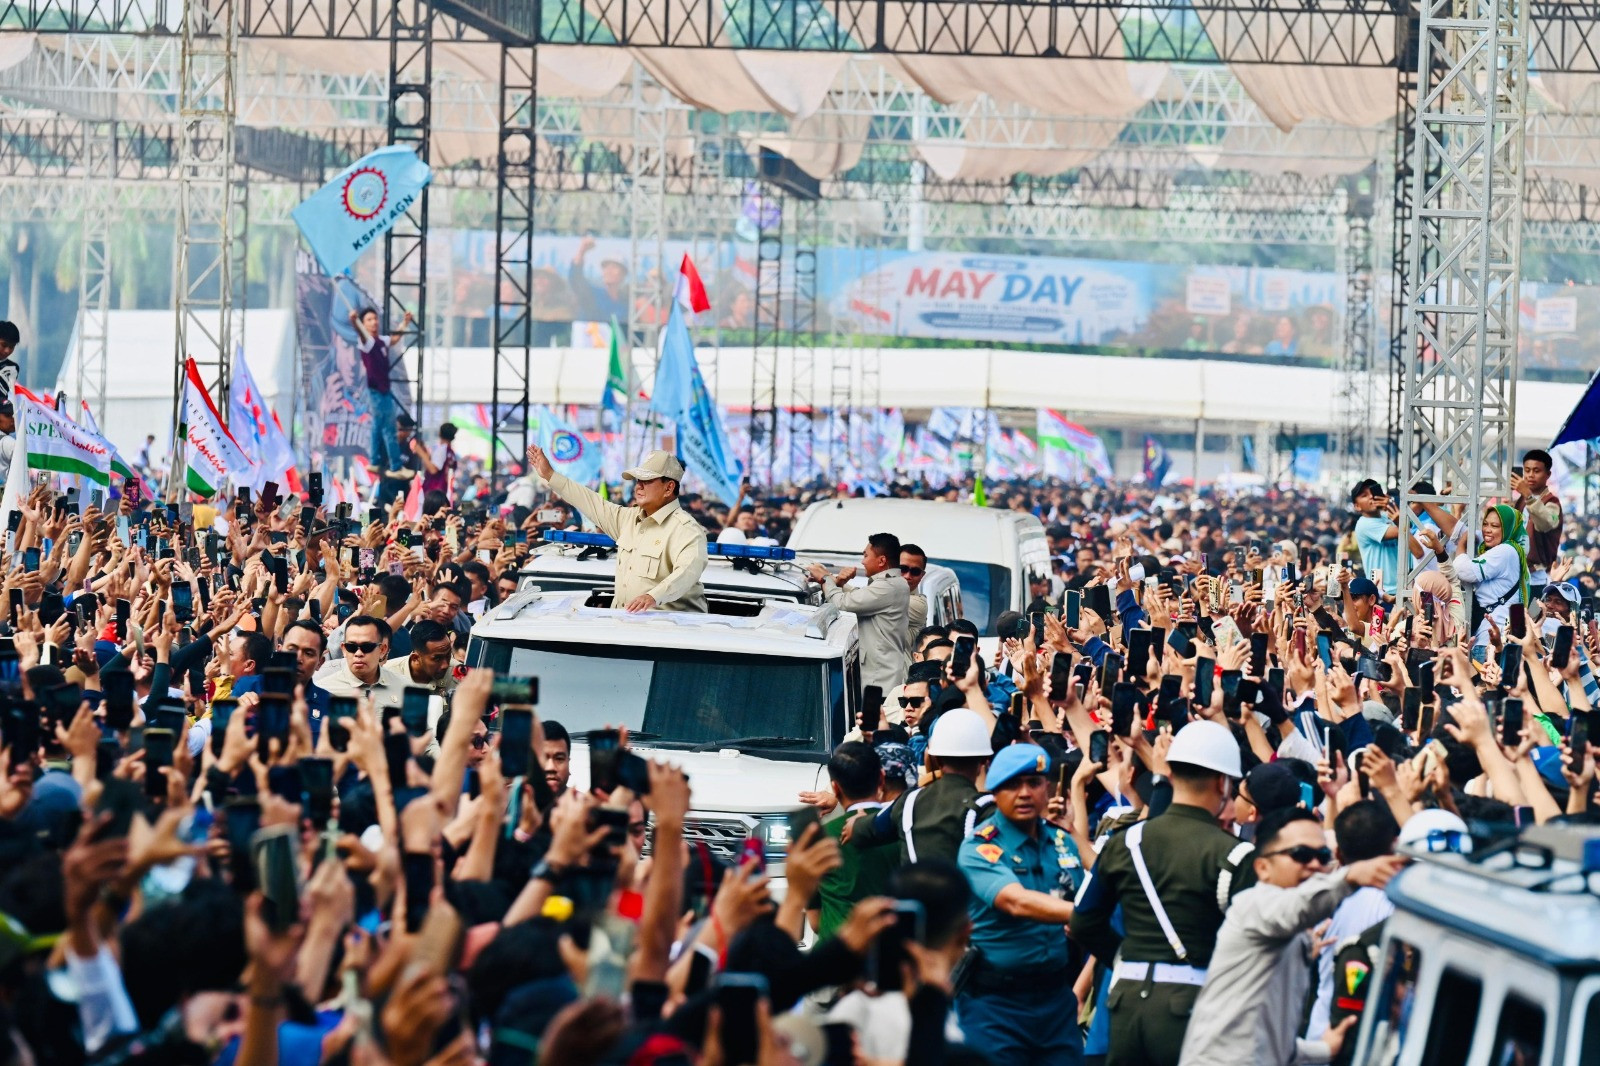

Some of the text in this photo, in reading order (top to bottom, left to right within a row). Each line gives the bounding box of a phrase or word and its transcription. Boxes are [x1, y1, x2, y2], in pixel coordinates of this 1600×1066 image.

[352, 195, 414, 250] KSPSI AGN
[906, 268, 995, 299] MAY
[1000, 273, 1084, 306] DAY
